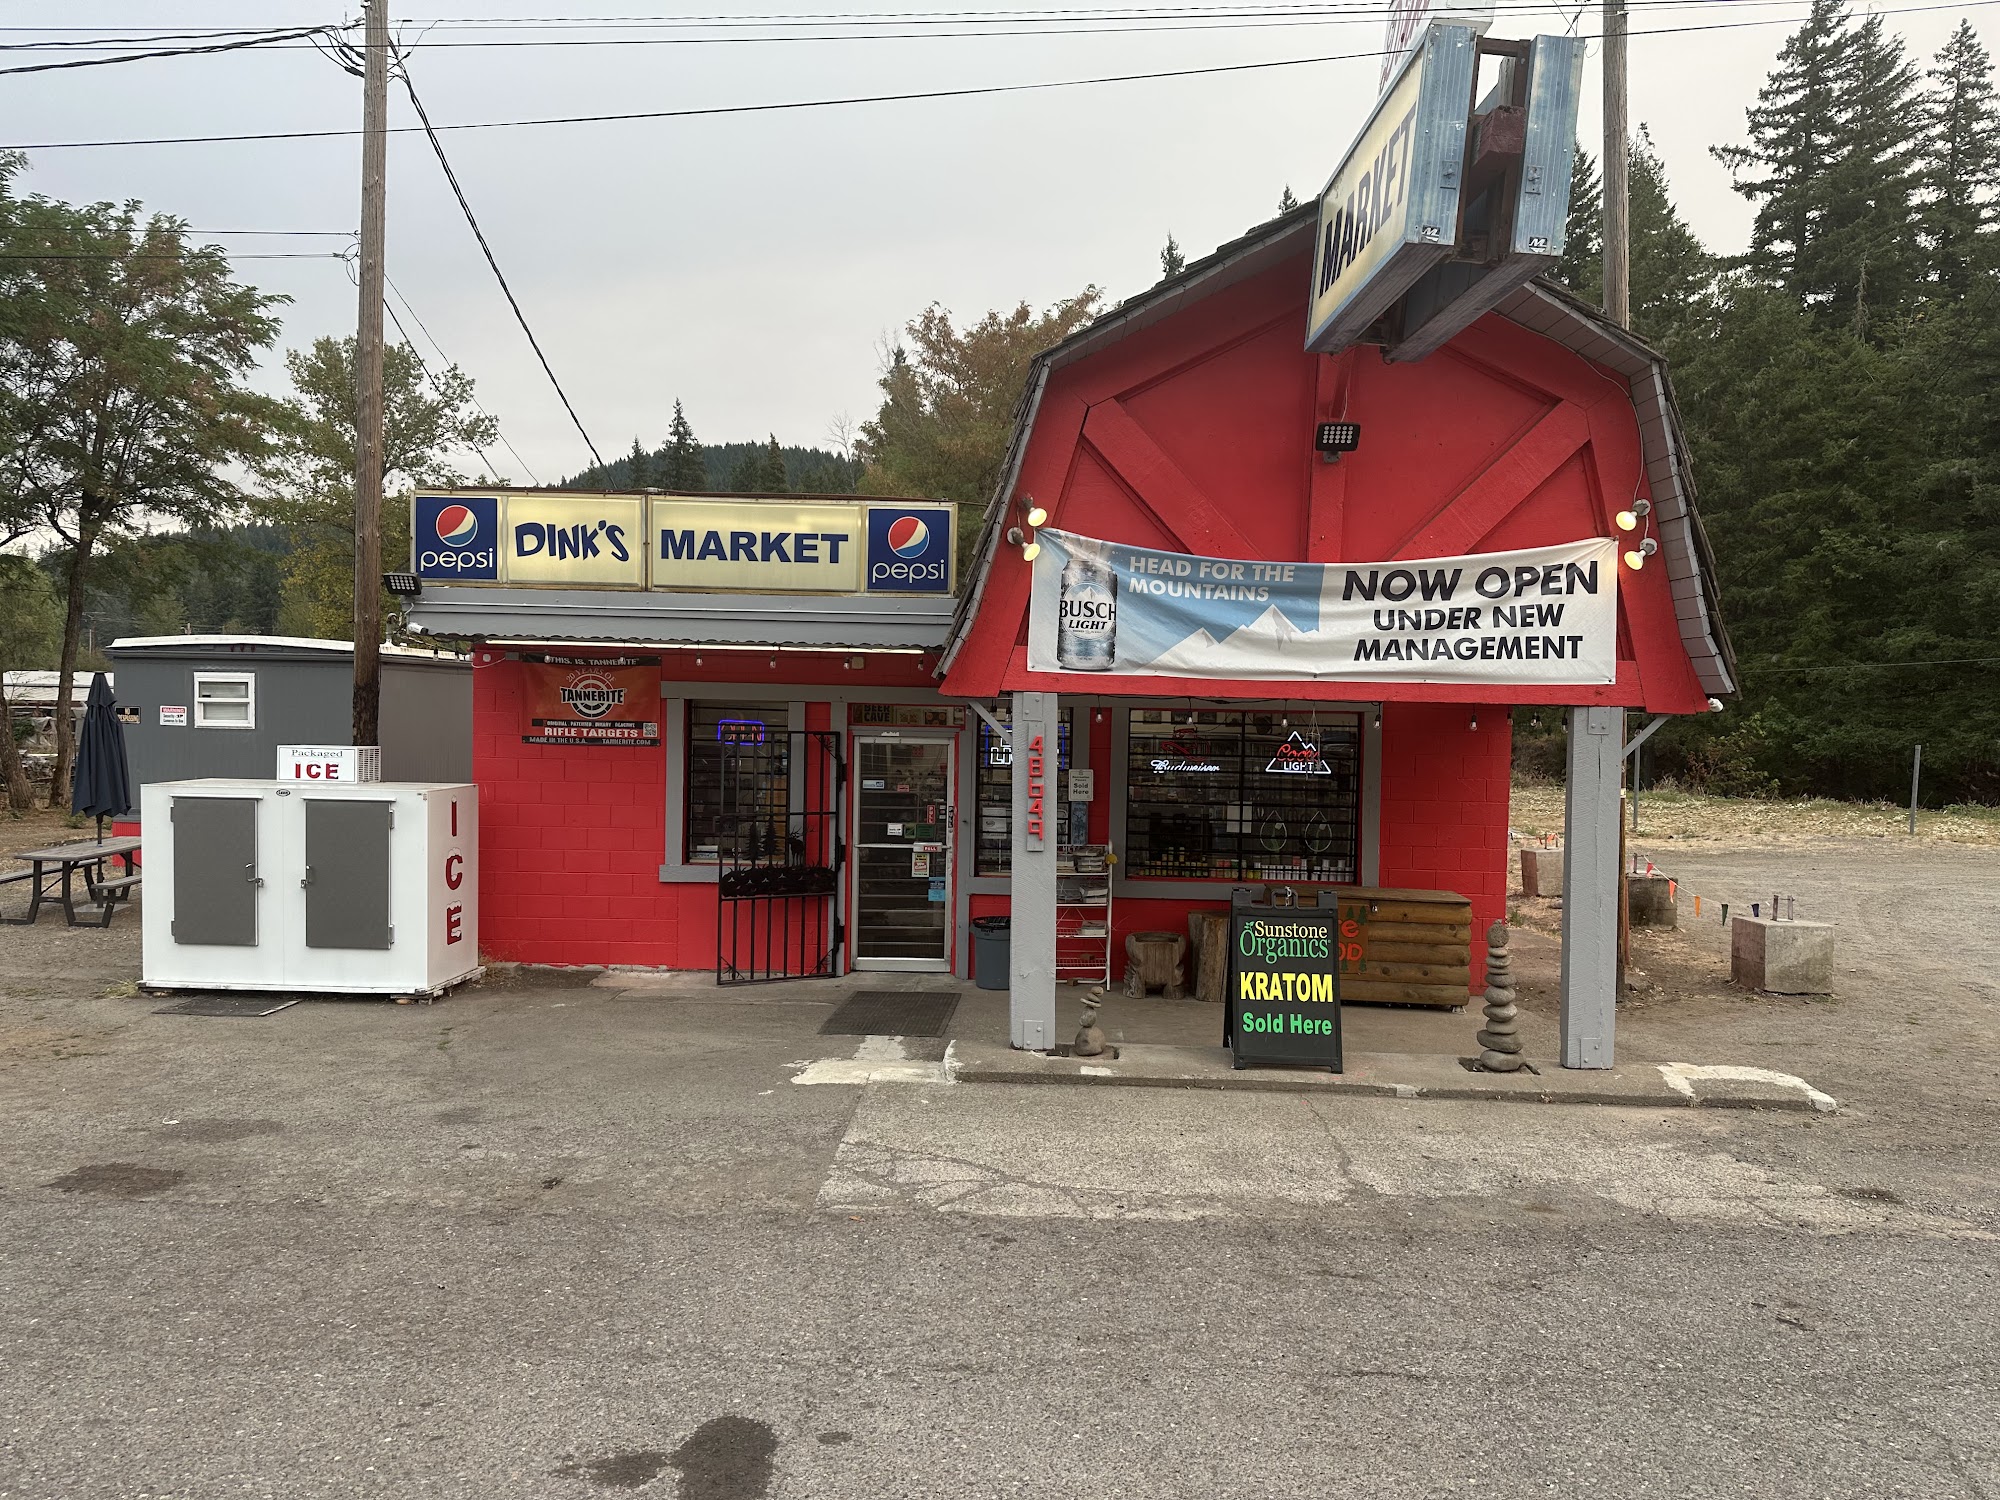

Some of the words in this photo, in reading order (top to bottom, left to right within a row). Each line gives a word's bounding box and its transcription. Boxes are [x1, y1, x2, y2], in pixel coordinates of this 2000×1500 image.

[1319, 101, 1417, 299] MARKET
[514, 520, 630, 562] DINK'S
[660, 529, 849, 564] MARKET
[420, 547, 494, 572] pepsi
[872, 559, 945, 584] pepsi
[1129, 556, 1192, 577] HEAD
[1199, 561, 1245, 581] FOR
[1252, 564, 1296, 582] THE
[1128, 577, 1270, 602] MOUNTAINS
[1342, 568, 1463, 602] NOW
[1474, 560, 1598, 599] OPEN
[1060, 600, 1117, 621] BUSCH
[1373, 607, 1482, 631] UNDER
[1492, 603, 1565, 628] NEW
[1068, 620, 1108, 630] LIGHT
[1353, 636, 1583, 661] MANAGEMENT
[566, 673, 576, 683] 20
[576, 667, 603, 676] YEARS
[605, 672, 617, 683] OF
[560, 687, 625, 704] TANNERITE
[864, 712, 890, 722] CAVE
[544, 727, 577, 737] RIFLE
[581, 728, 639, 737] TARGETS
[291, 749, 343, 758] Packaged
[1150, 759, 1221, 773] Budweiser
[1283, 761, 1314, 771] LIGHT
[294, 761, 339, 779] ICE
[1028, 735, 1044, 841] 48649
[445, 795, 463, 945] ICE
[1254, 920, 1328, 939] Sunstone
[1239, 929, 1329, 964] Organics
[1240, 971, 1334, 1003] KRATOM
[1242, 1012, 1284, 1034] Sold
[1290, 1013, 1332, 1035] Here
